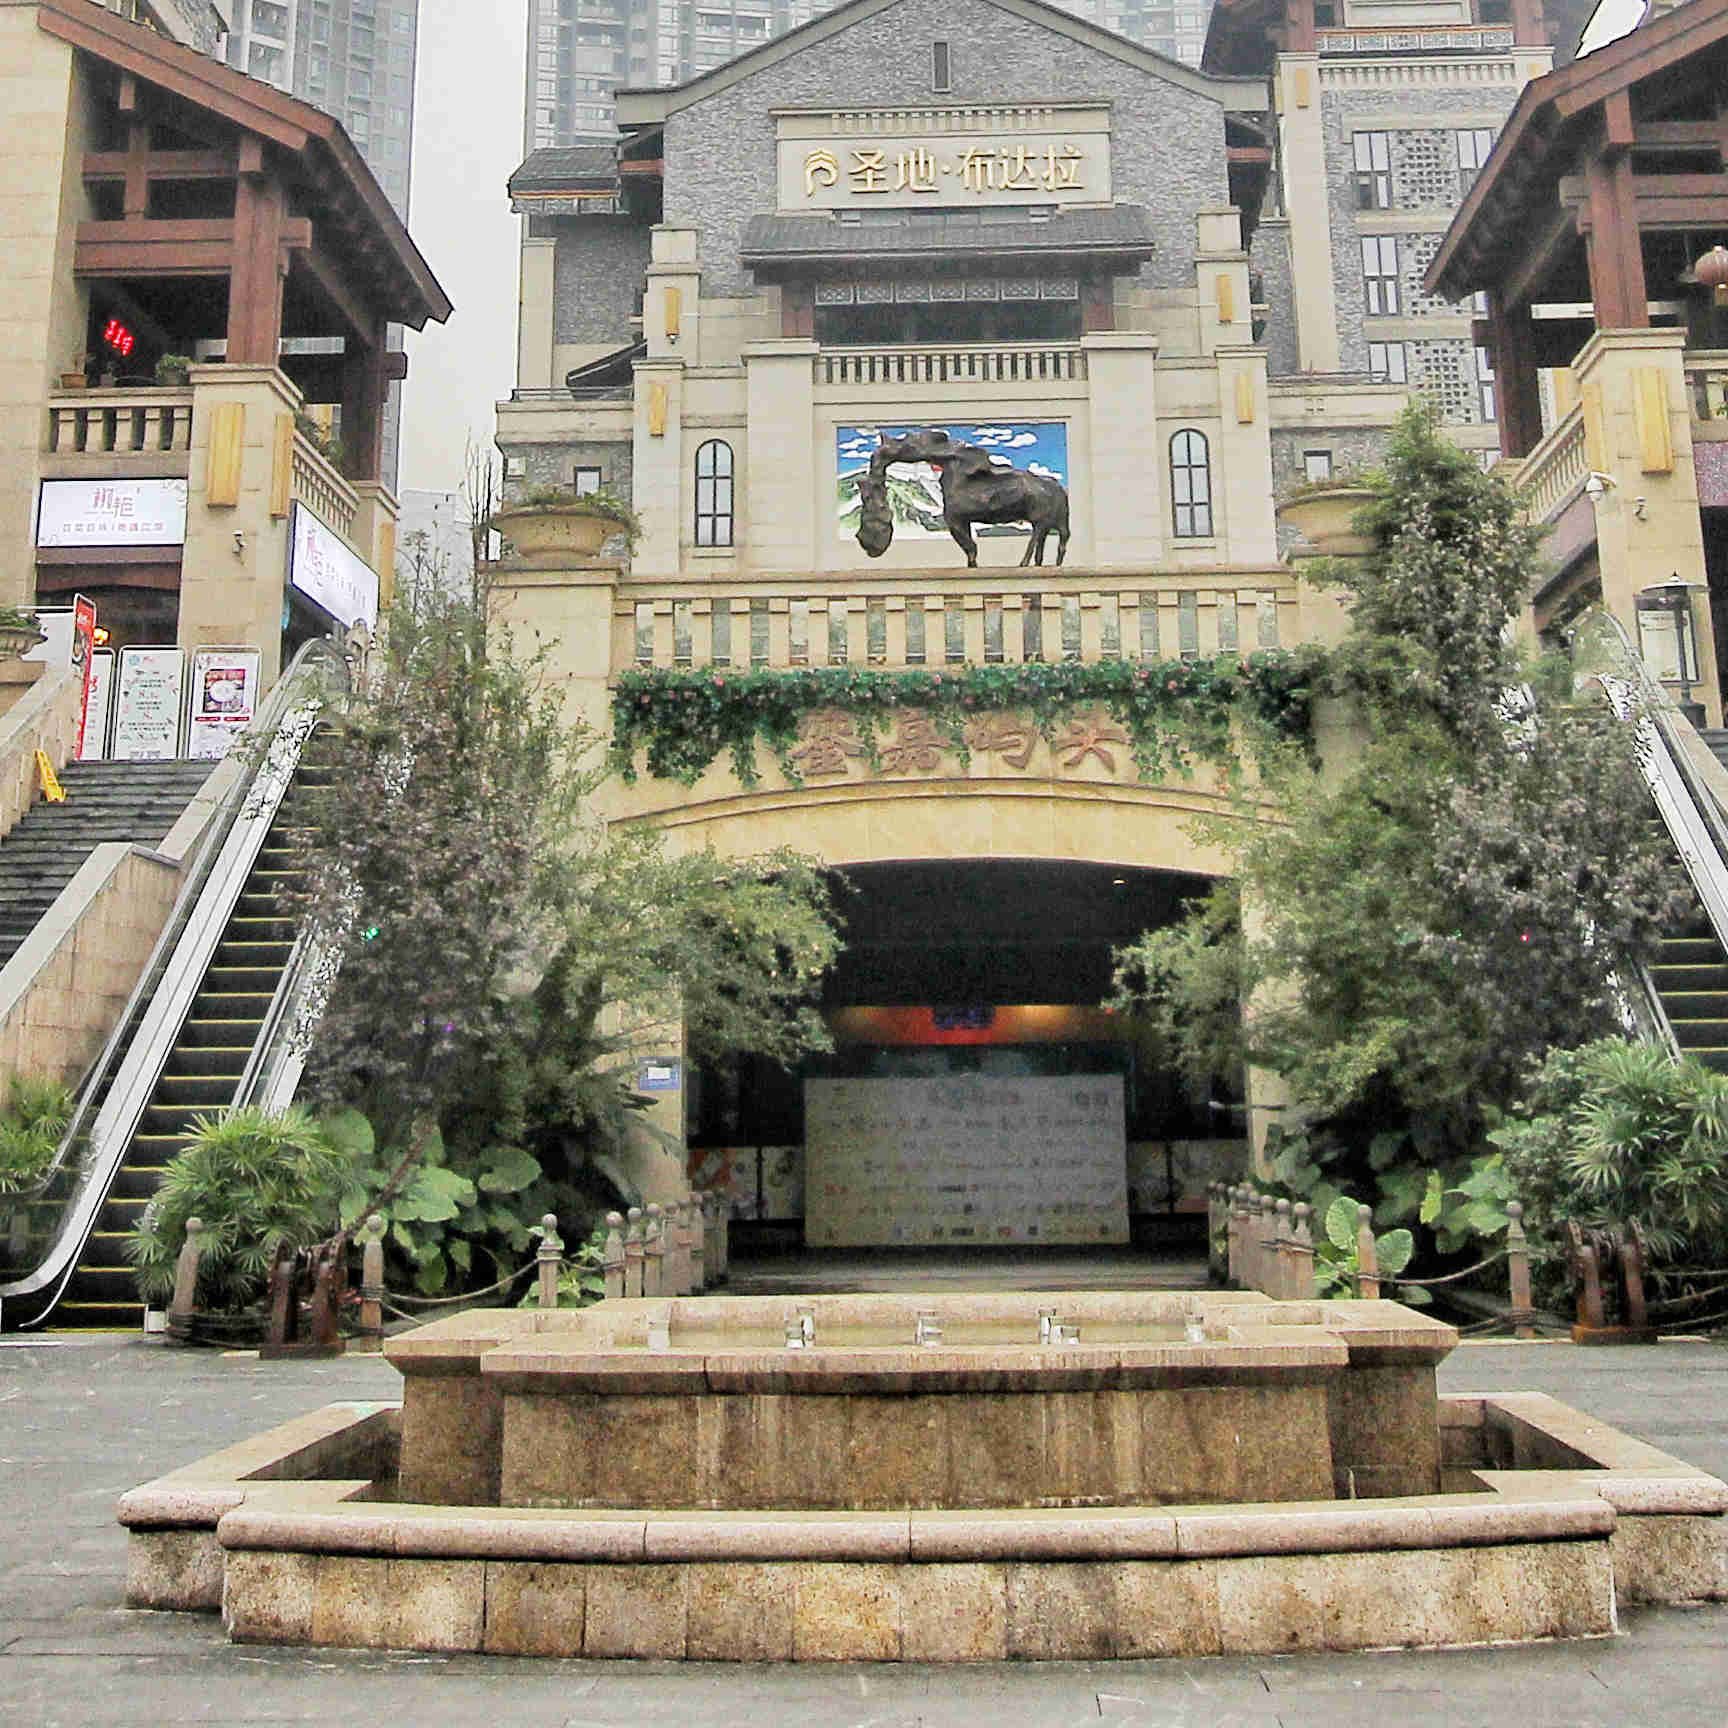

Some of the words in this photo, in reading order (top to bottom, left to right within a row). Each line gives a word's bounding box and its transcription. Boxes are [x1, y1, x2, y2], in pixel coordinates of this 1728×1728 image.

[847, 142, 1086, 196] 圣地·布达拉
